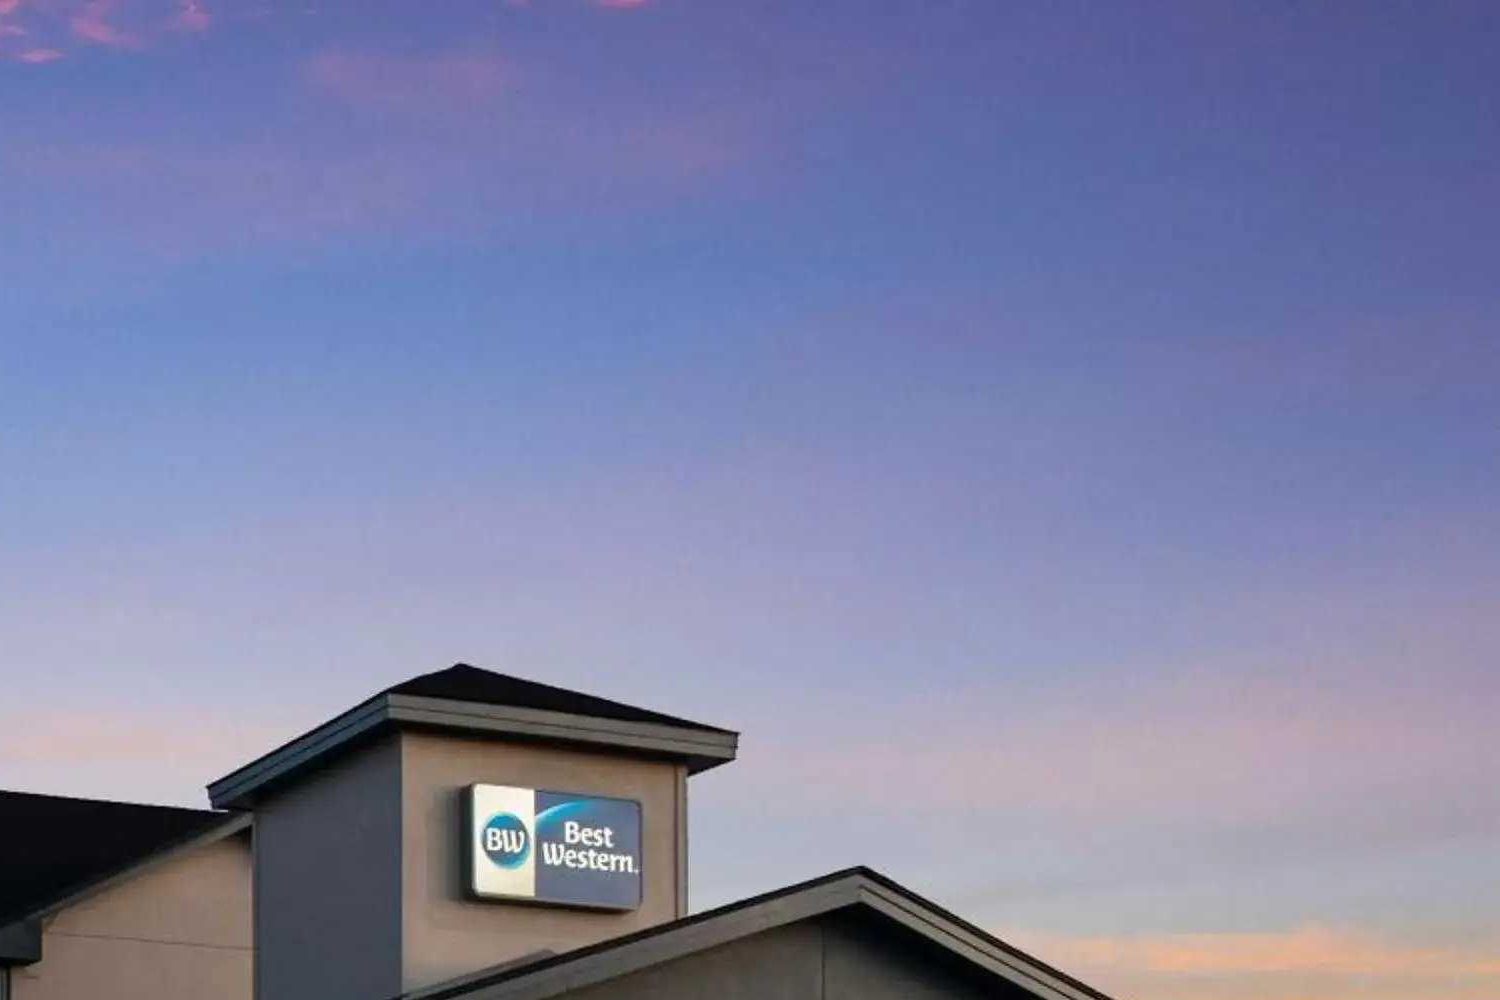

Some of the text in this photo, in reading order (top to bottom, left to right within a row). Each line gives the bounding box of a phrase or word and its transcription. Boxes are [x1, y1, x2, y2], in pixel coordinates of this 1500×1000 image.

[486, 827, 525, 853] BW
[564, 821, 615, 848] Best
[542, 842, 634, 873] Western
